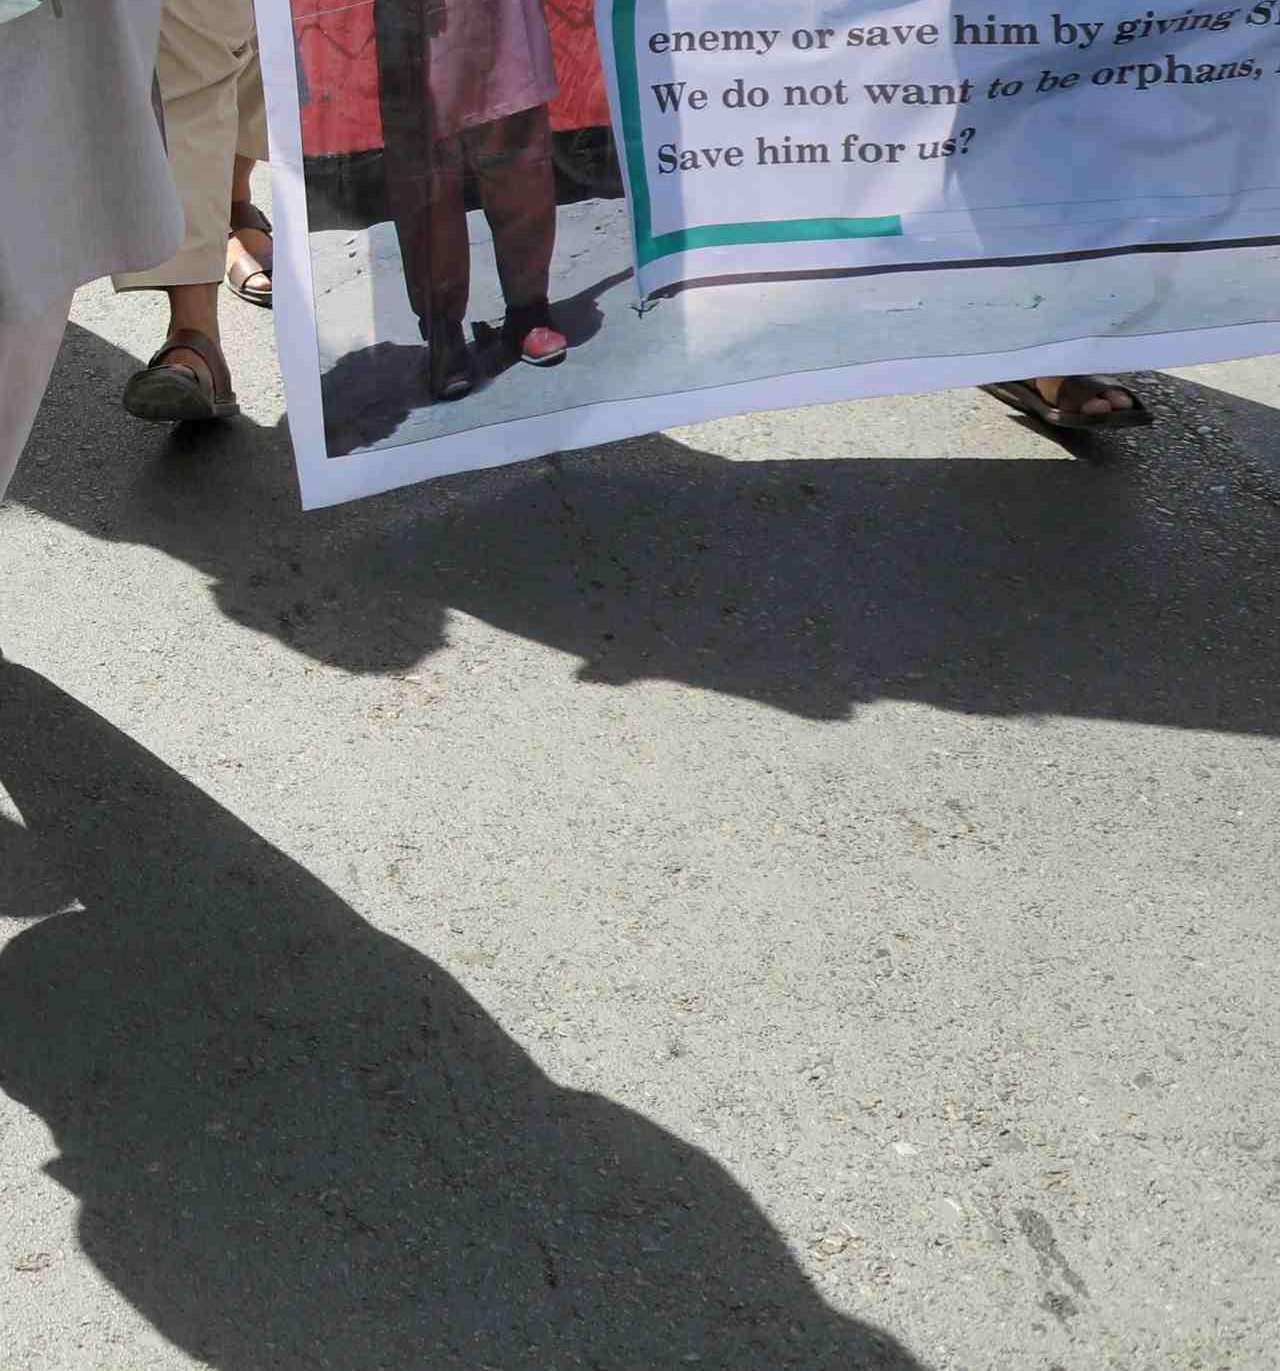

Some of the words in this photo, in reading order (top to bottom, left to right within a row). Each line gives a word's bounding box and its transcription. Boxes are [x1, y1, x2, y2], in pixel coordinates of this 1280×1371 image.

[649, 30, 781, 55] enemy
[792, 28, 835, 50] or
[847, 24, 939, 46] save
[953, 14, 1040, 45] him
[1051, 14, 1104, 49] by
[1114, 9, 1241, 45] giving
[651, 82, 708, 113] We
[722, 79, 769, 108] do
[784, 79, 848, 106] not
[863, 79, 974, 105] want
[988, 78, 1024, 99] to
[1036, 70, 1080, 92] be
[1092, 54, 1262, 90] orphans,
[658, 143, 744, 174] Save
[755, 136, 830, 165] him
[841, 134, 906, 163] for
[917, 128, 976, 162] us?
